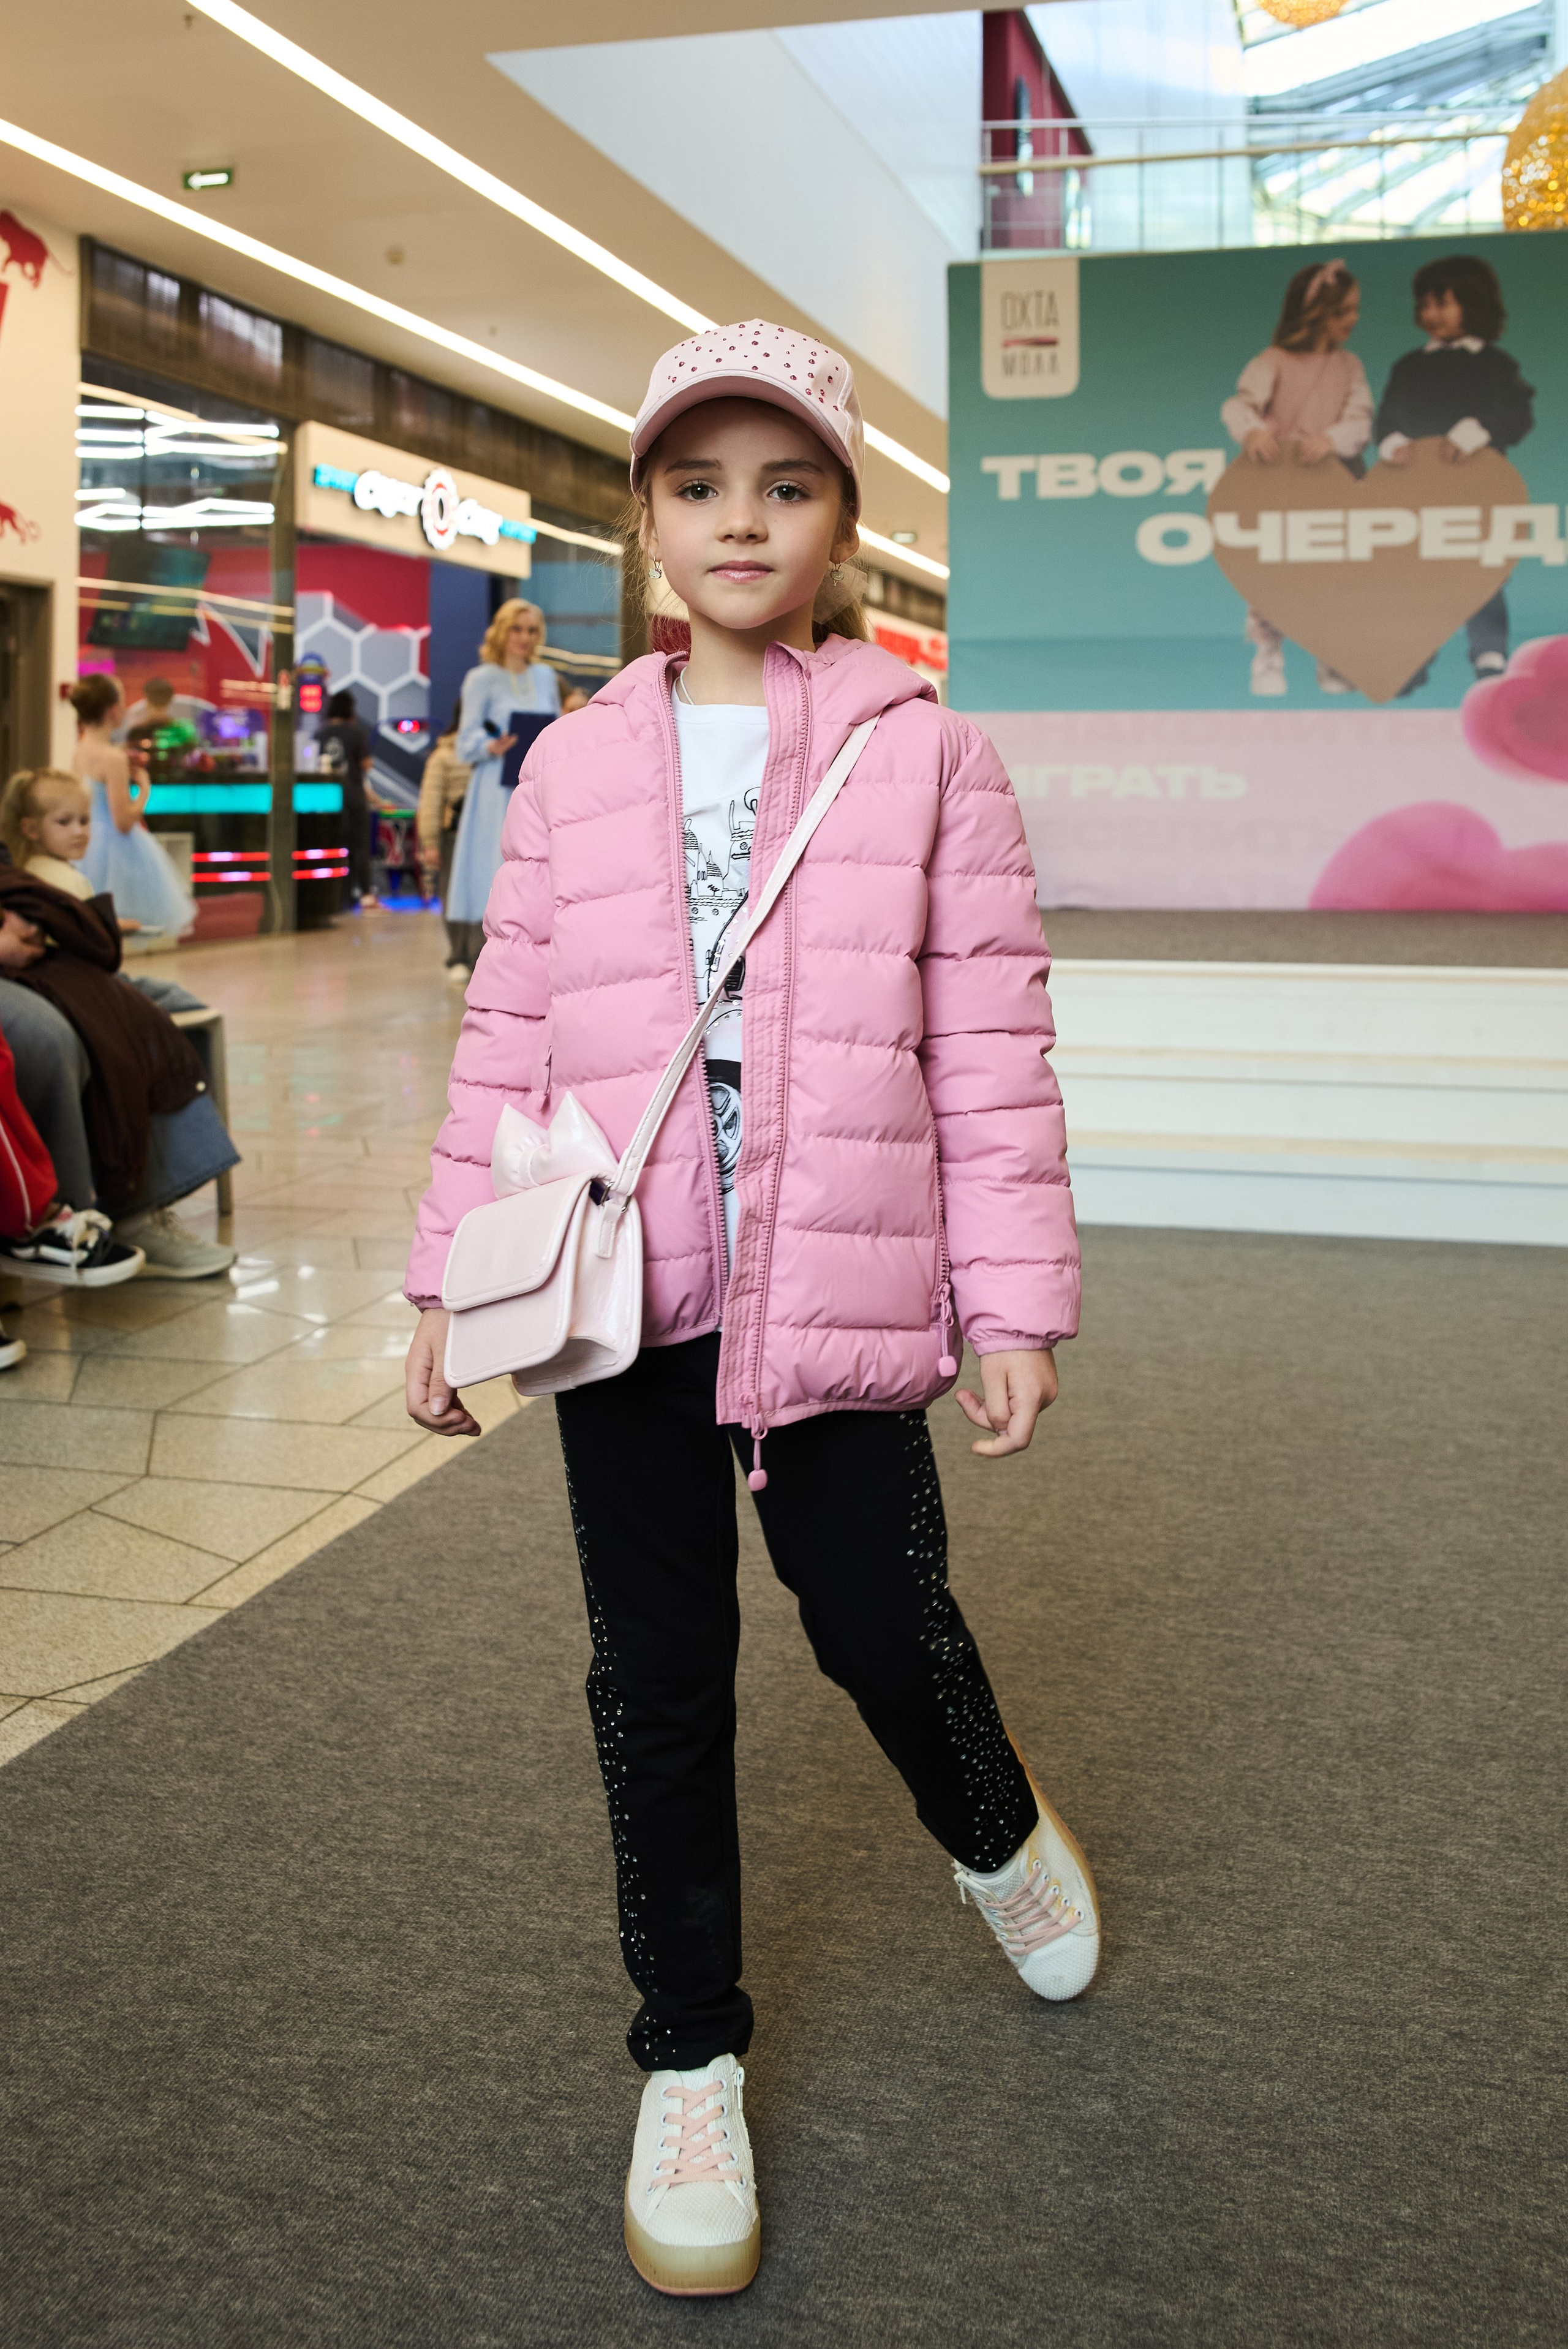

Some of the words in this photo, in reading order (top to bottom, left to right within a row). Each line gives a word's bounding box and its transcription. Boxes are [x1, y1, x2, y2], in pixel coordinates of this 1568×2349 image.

[1000, 290, 1060, 330] ОХТА
[981, 448, 1226, 500] ТВОЯ
[1136, 503, 1568, 567] ОЧЕРЕД
